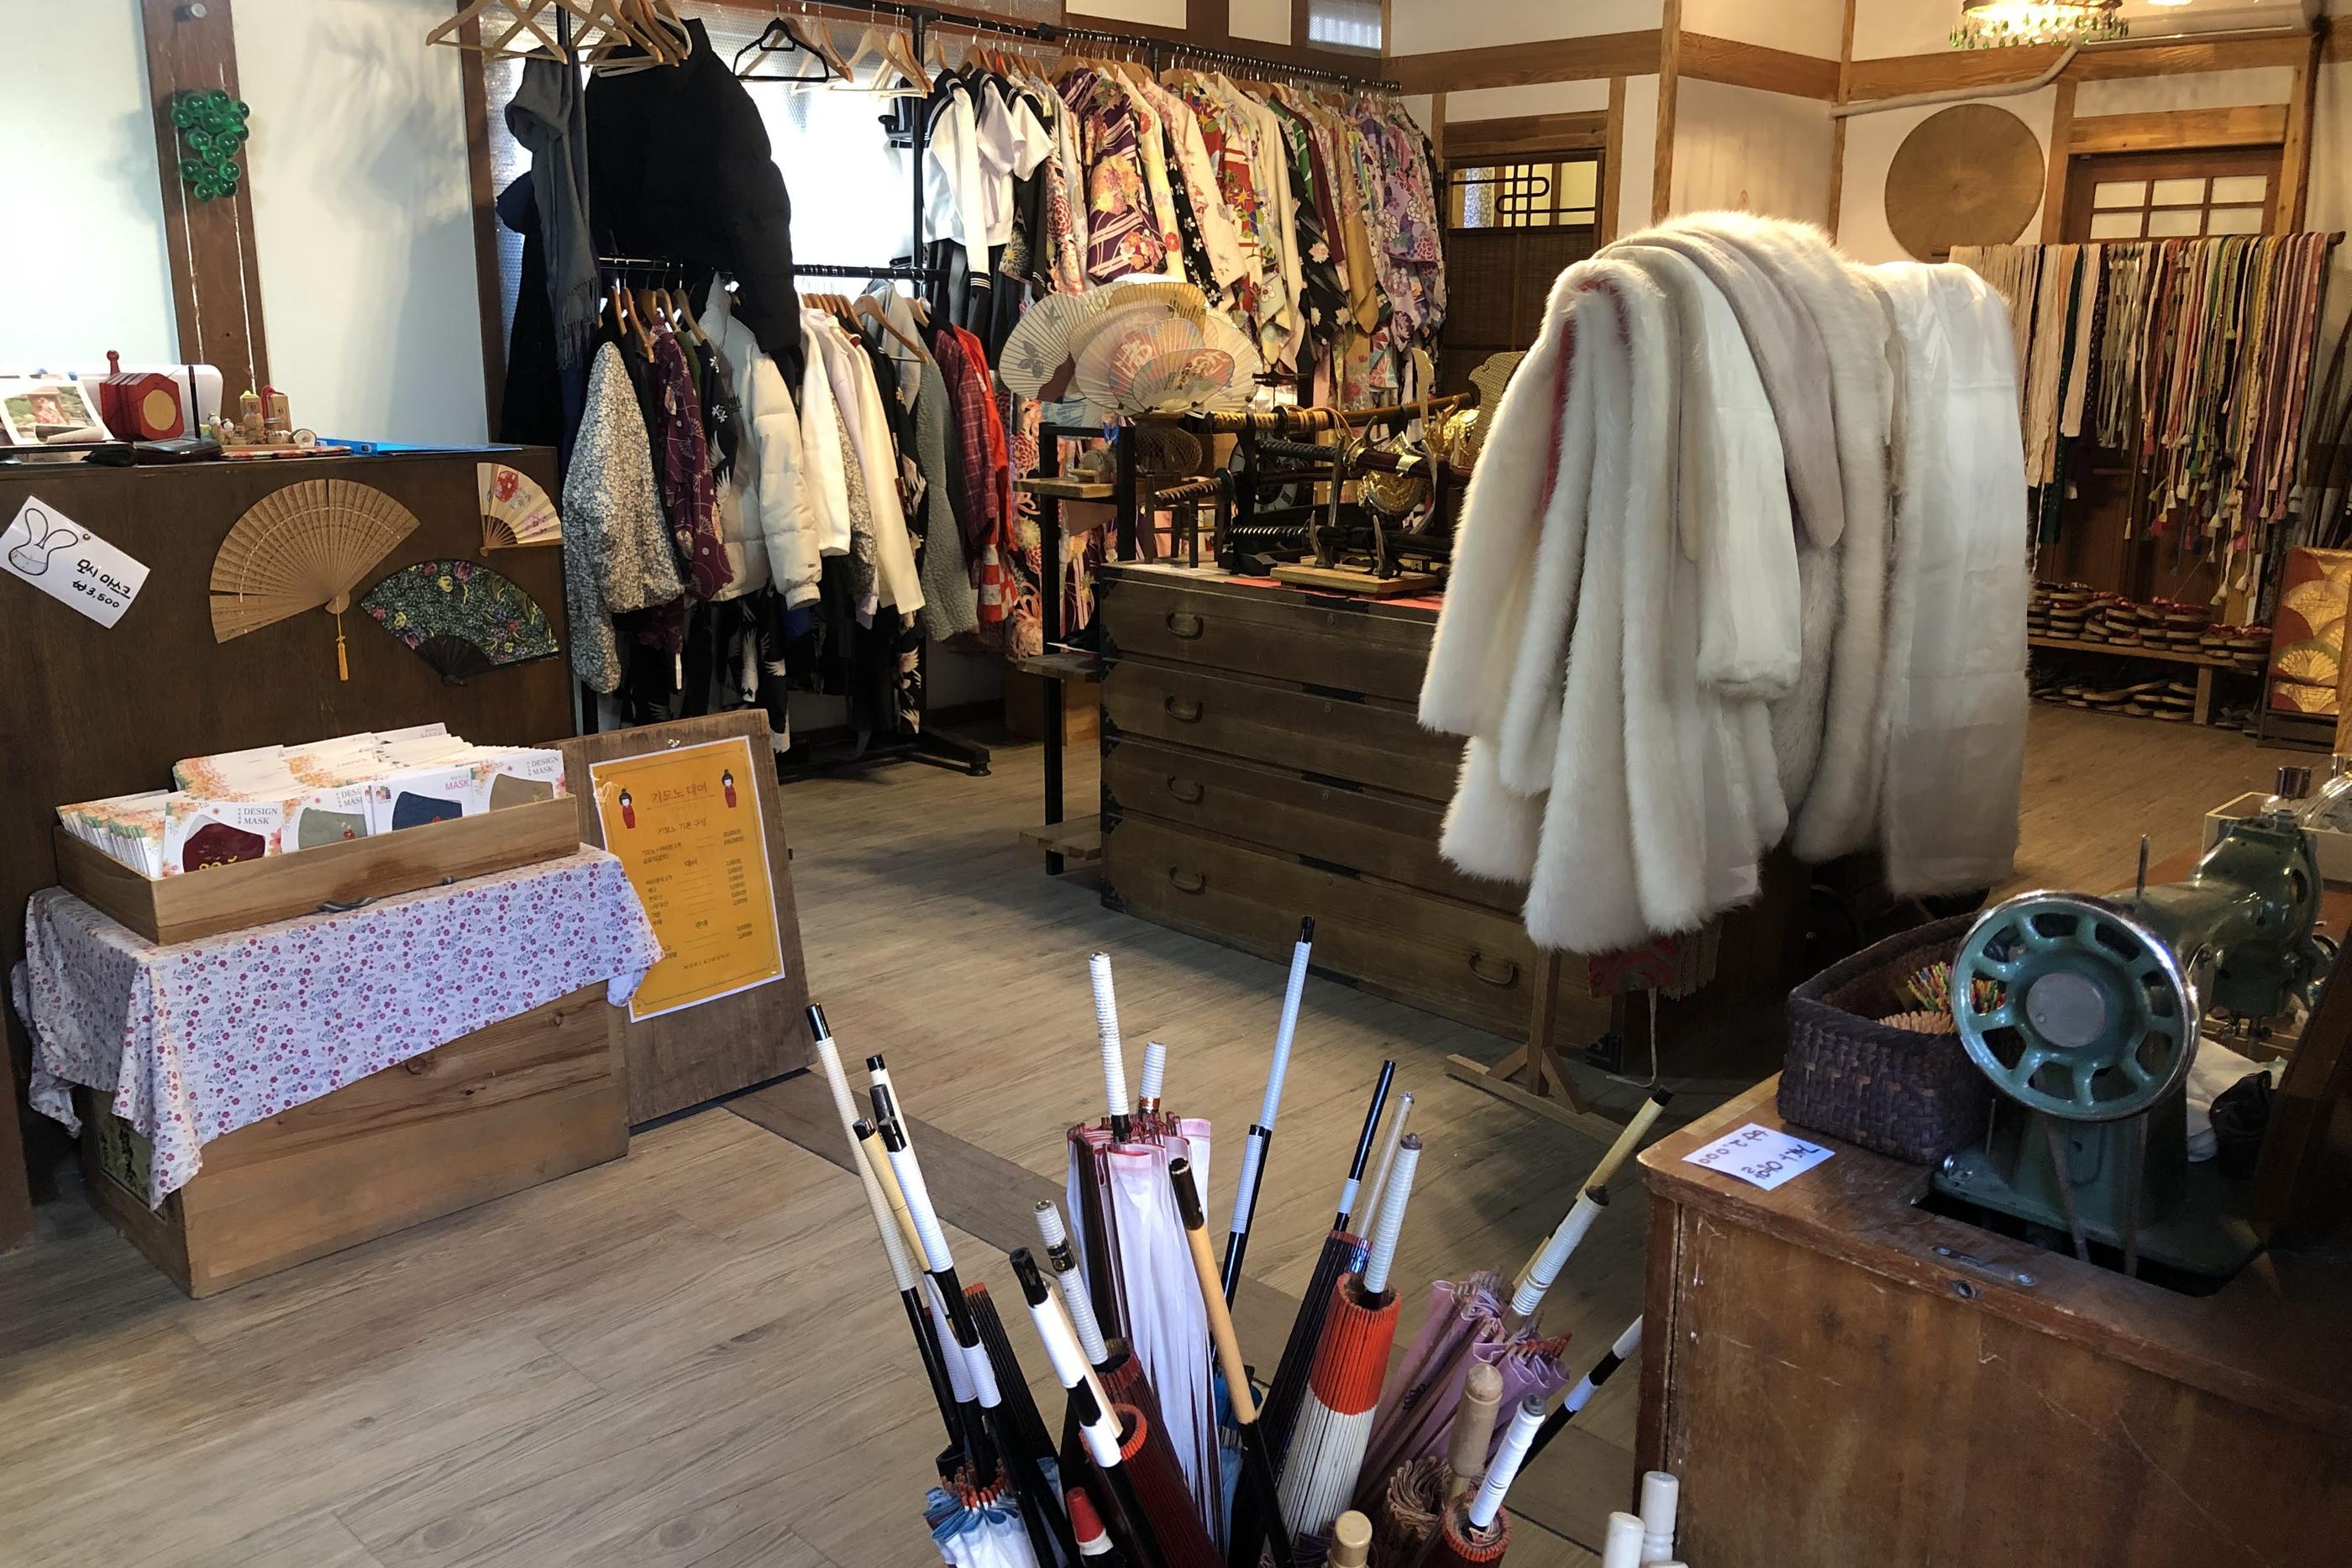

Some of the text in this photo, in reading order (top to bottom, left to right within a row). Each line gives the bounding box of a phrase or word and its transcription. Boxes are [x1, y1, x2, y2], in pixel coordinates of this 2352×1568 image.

[76, 559, 131, 600] 모시 마스크
[531, 756, 559, 767] DESIGN
[533, 766, 554, 774] MASK
[445, 779, 470, 790] MASK
[652, 781, 708, 804] 기모노 대여
[344, 797, 362, 806] MAS
[659, 825, 678, 834] 기모노
